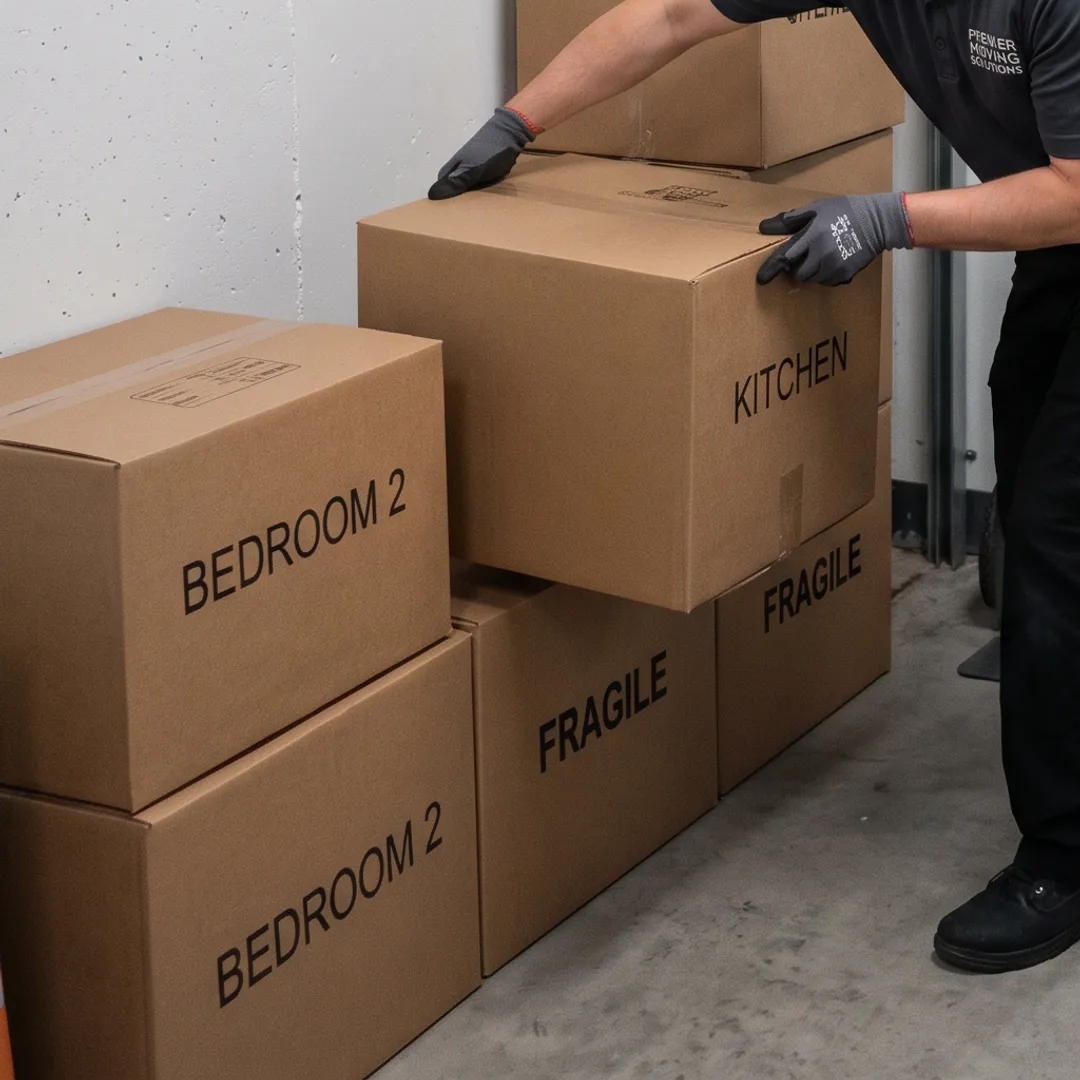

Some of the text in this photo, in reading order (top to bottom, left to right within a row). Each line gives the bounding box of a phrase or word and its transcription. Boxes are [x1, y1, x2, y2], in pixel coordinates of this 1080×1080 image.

[969, 41, 1020, 64] MOVING
[734, 330, 848, 425] KITCHEN
[182, 468, 406, 616] BEDROOM 2
[763, 533, 862, 634] FRAGILE
[539, 649, 668, 774] FRAGILE
[216, 801, 443, 1009] BEDROOM 2
